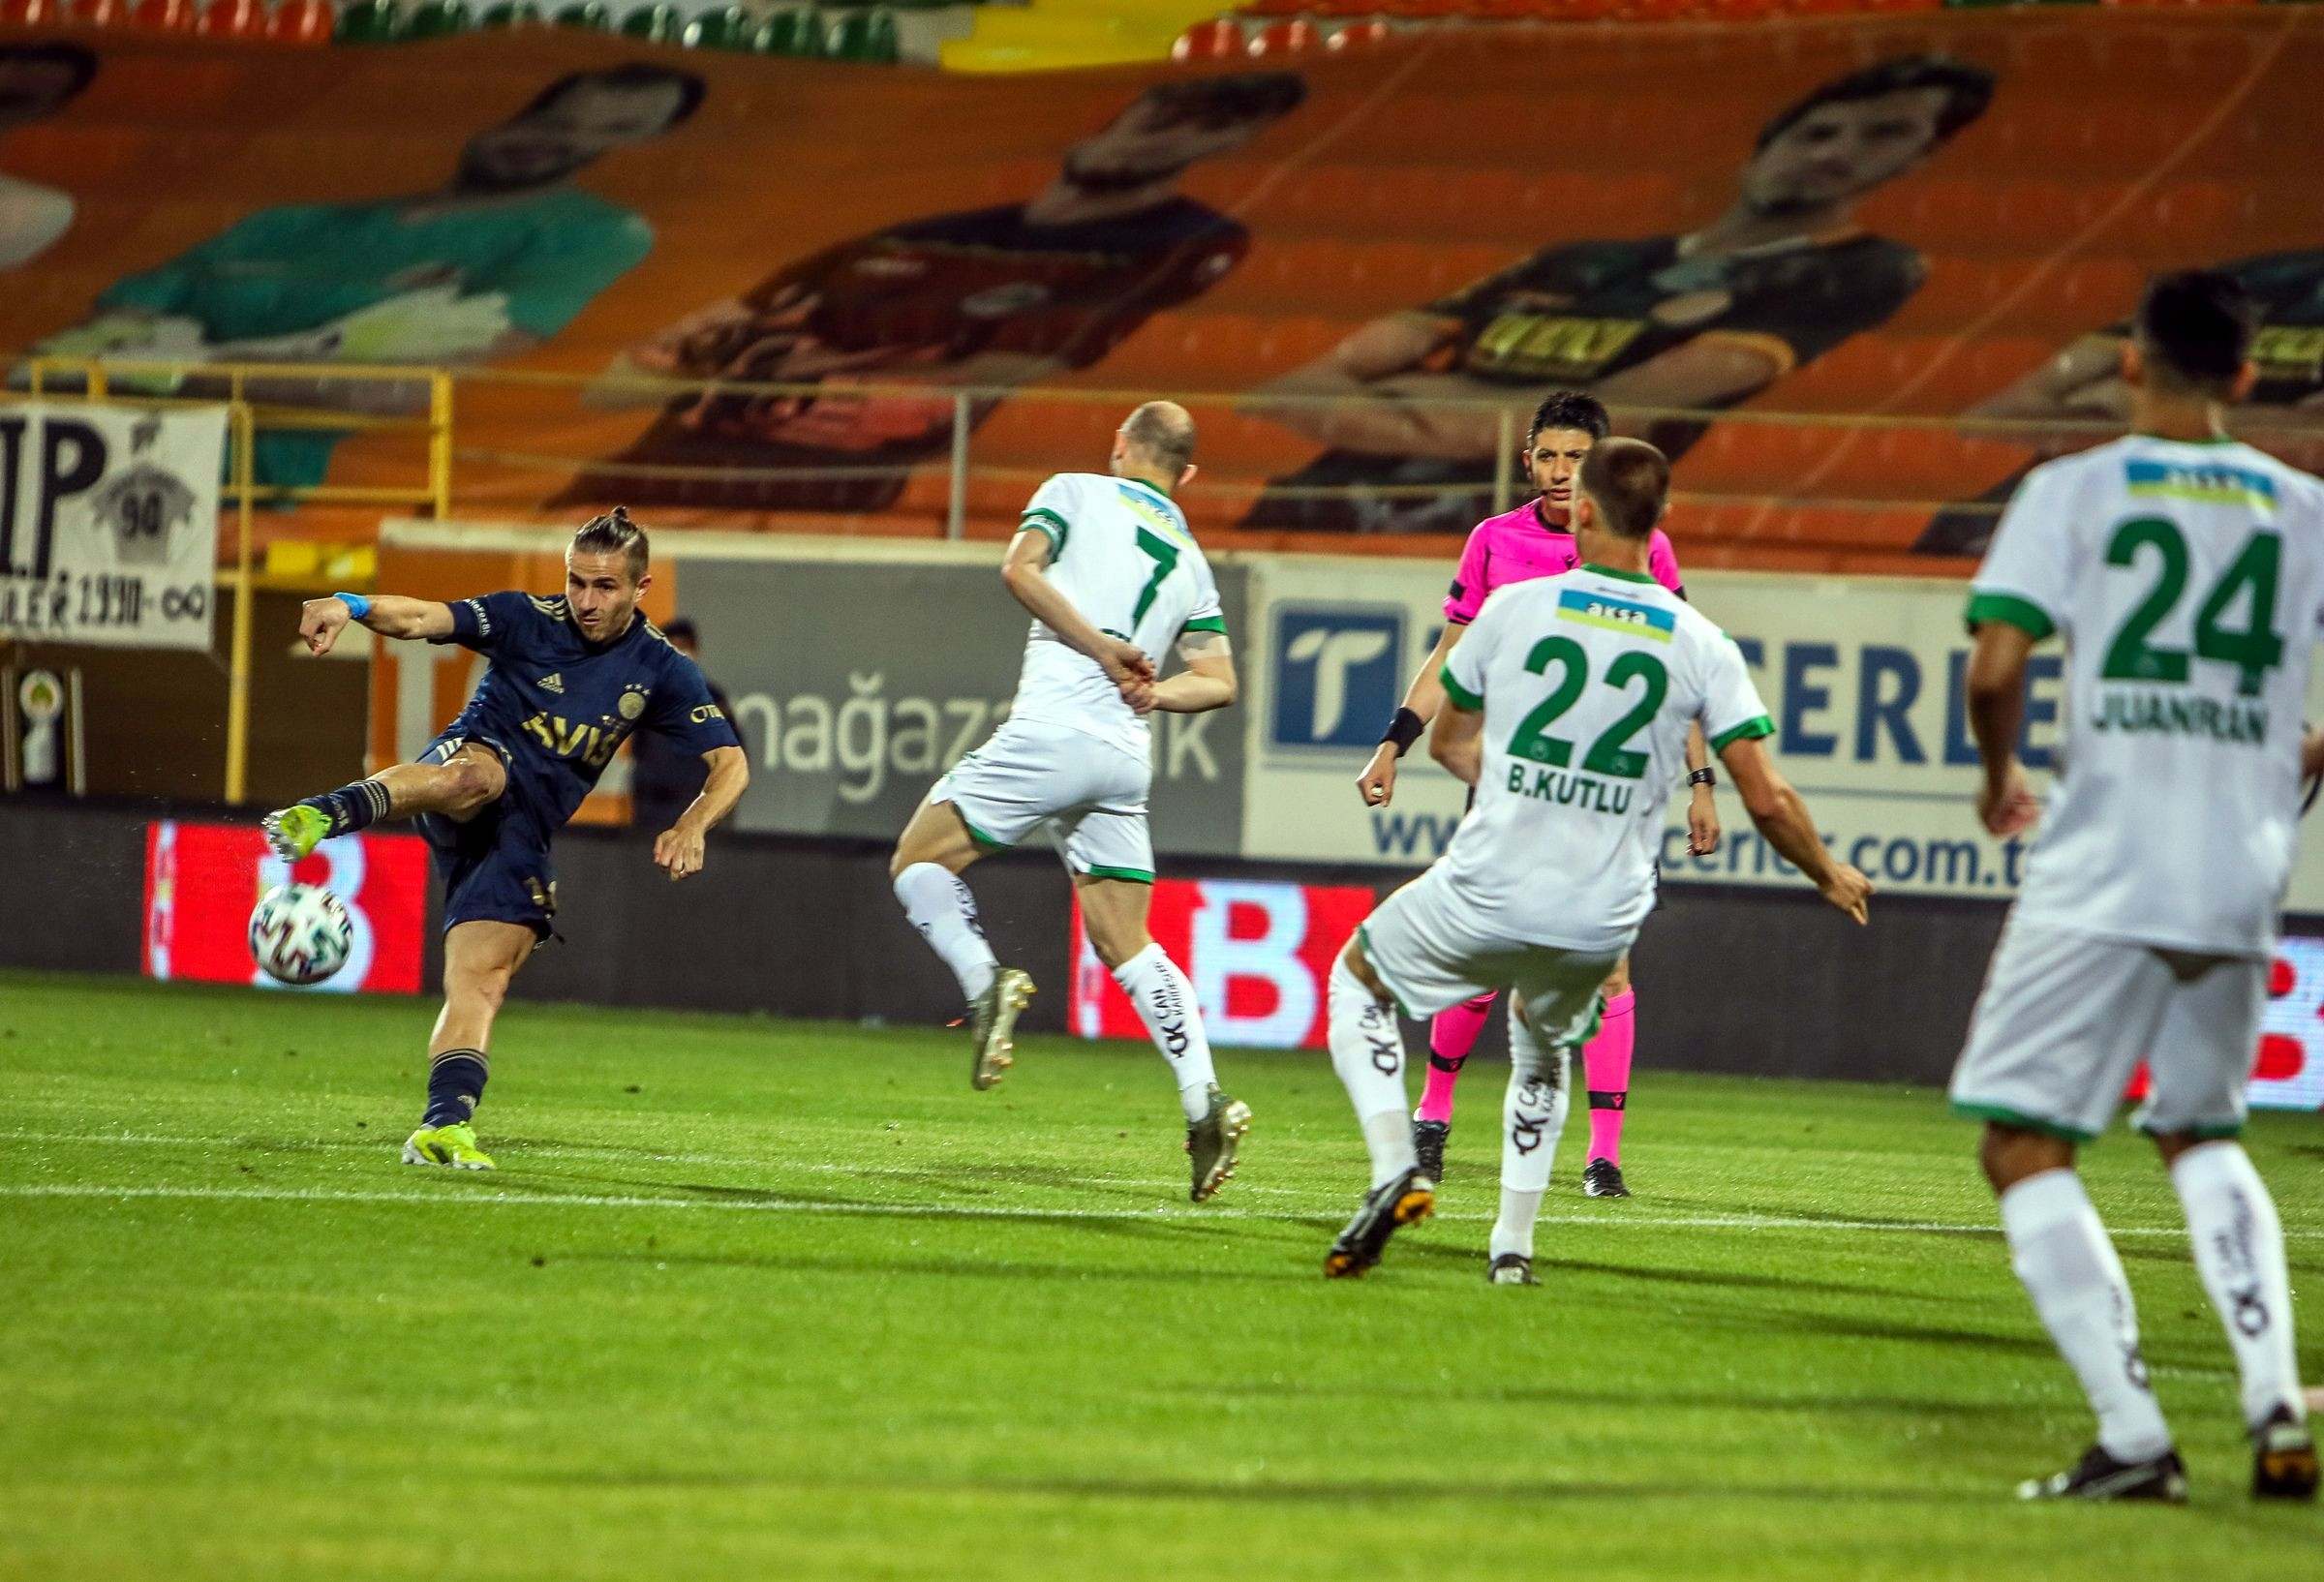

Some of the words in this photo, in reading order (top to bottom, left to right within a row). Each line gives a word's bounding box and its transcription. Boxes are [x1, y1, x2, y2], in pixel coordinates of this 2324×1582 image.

[1132, 524, 1181, 634] 7
[1586, 599, 1648, 625] aksa
[2102, 514, 2283, 697] 24
[1507, 634, 1667, 780] 22
[1507, 763, 1633, 816] B.KUTLU
[1188, 880, 1318, 1048] B
